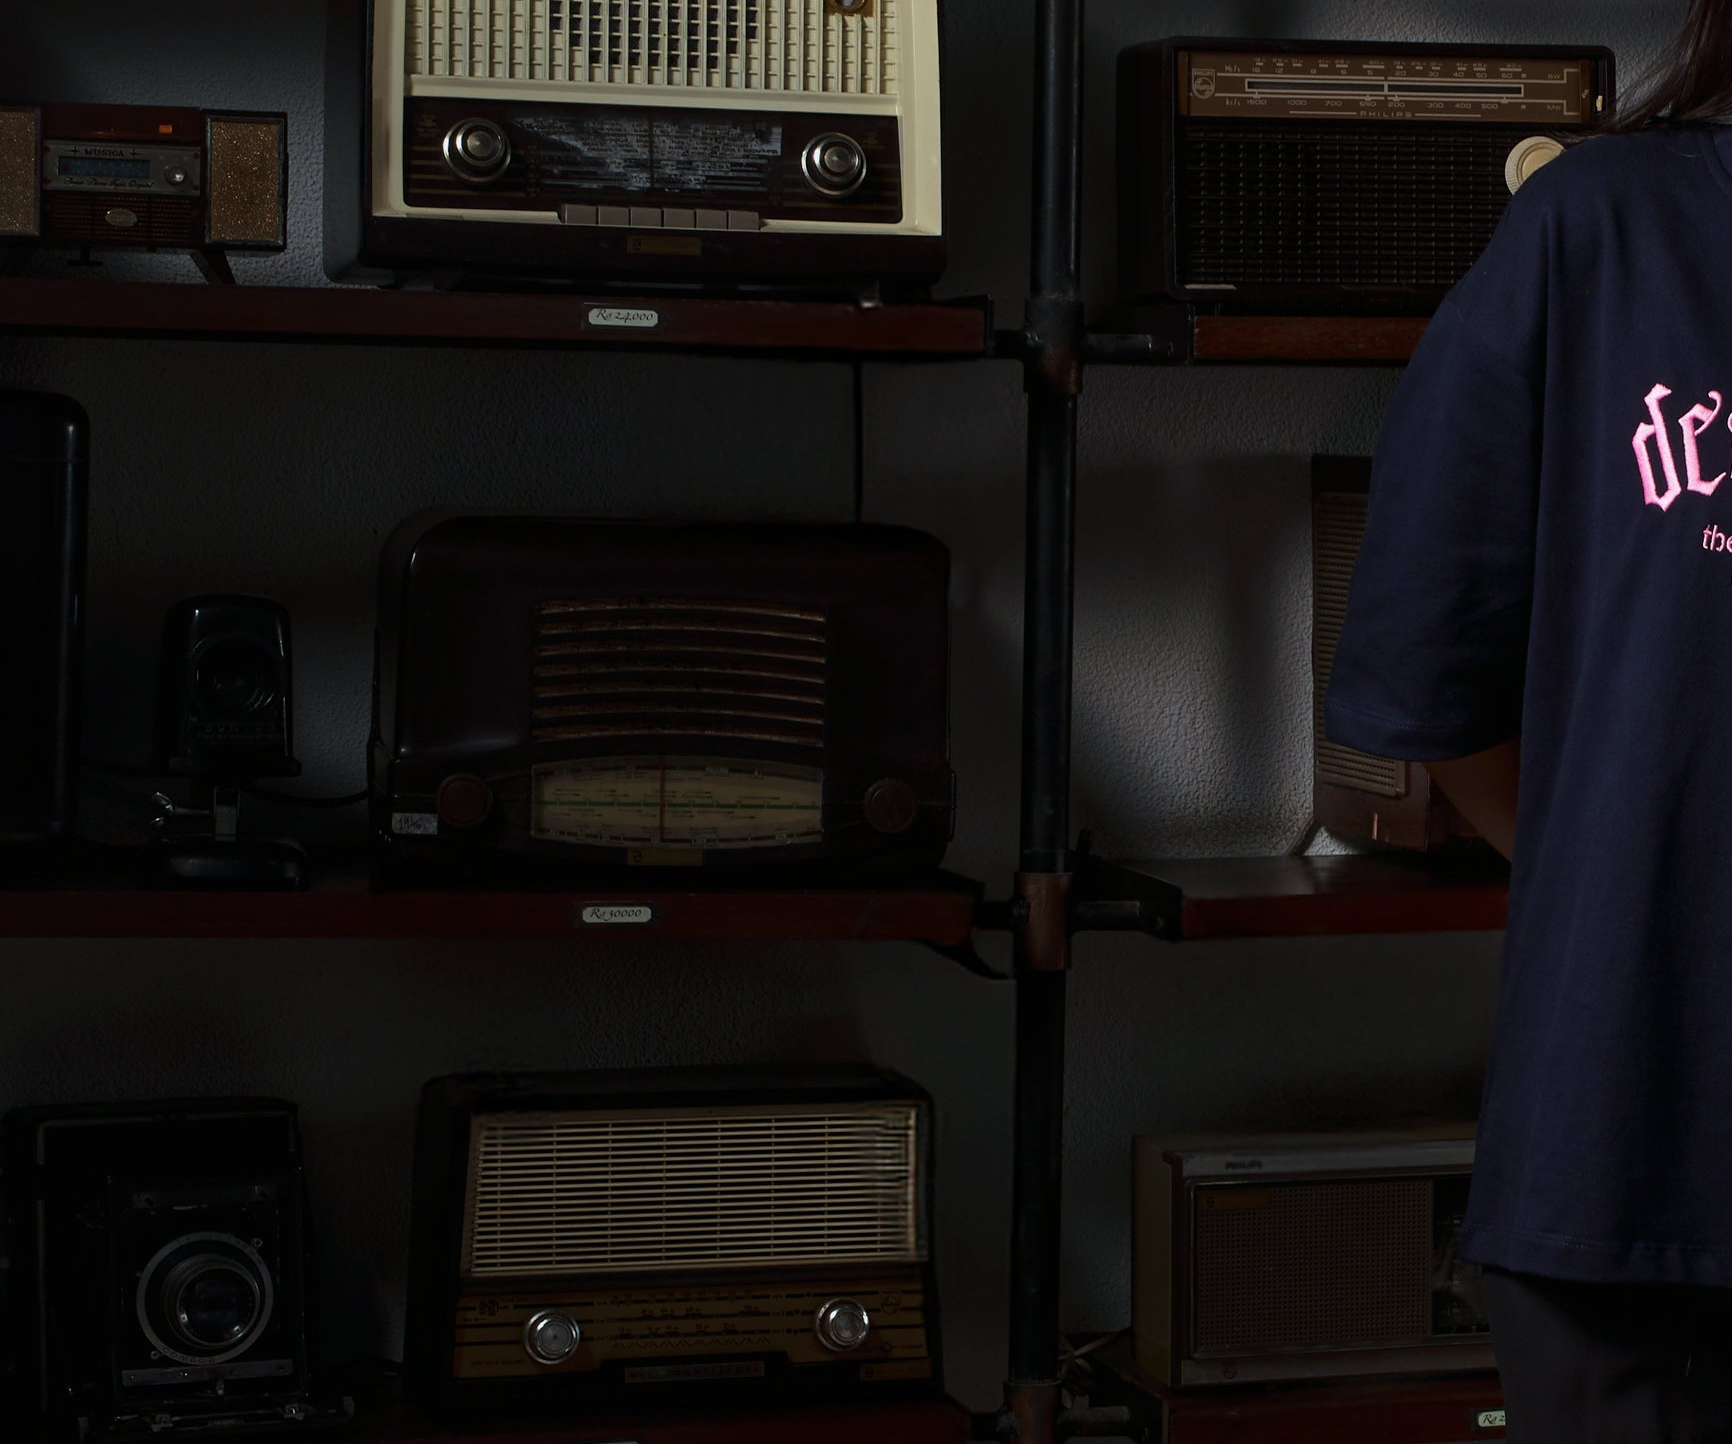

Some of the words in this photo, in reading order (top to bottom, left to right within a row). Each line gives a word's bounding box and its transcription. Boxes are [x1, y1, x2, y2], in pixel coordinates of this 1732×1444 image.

[1360, 111, 1412, 119] PHILIPS
[84, 148, 125, 158] MUSICA
[606, 909, 642, 922] 30000
